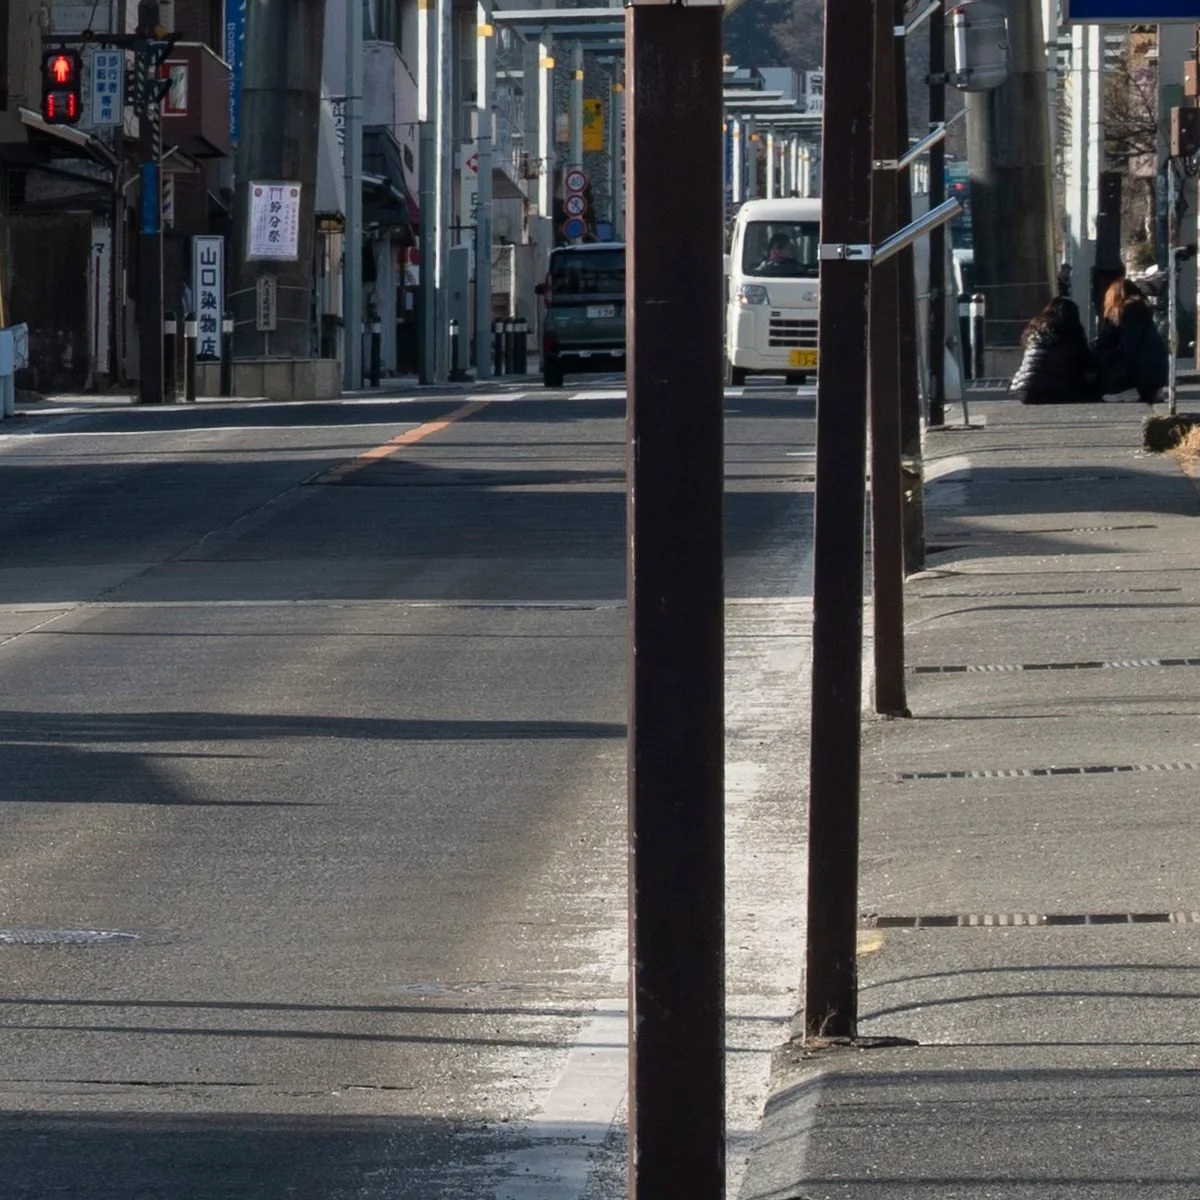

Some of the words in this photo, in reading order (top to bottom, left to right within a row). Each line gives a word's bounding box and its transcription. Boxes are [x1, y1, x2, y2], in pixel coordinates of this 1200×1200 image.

[200, 246, 217, 355] 山口染物店
